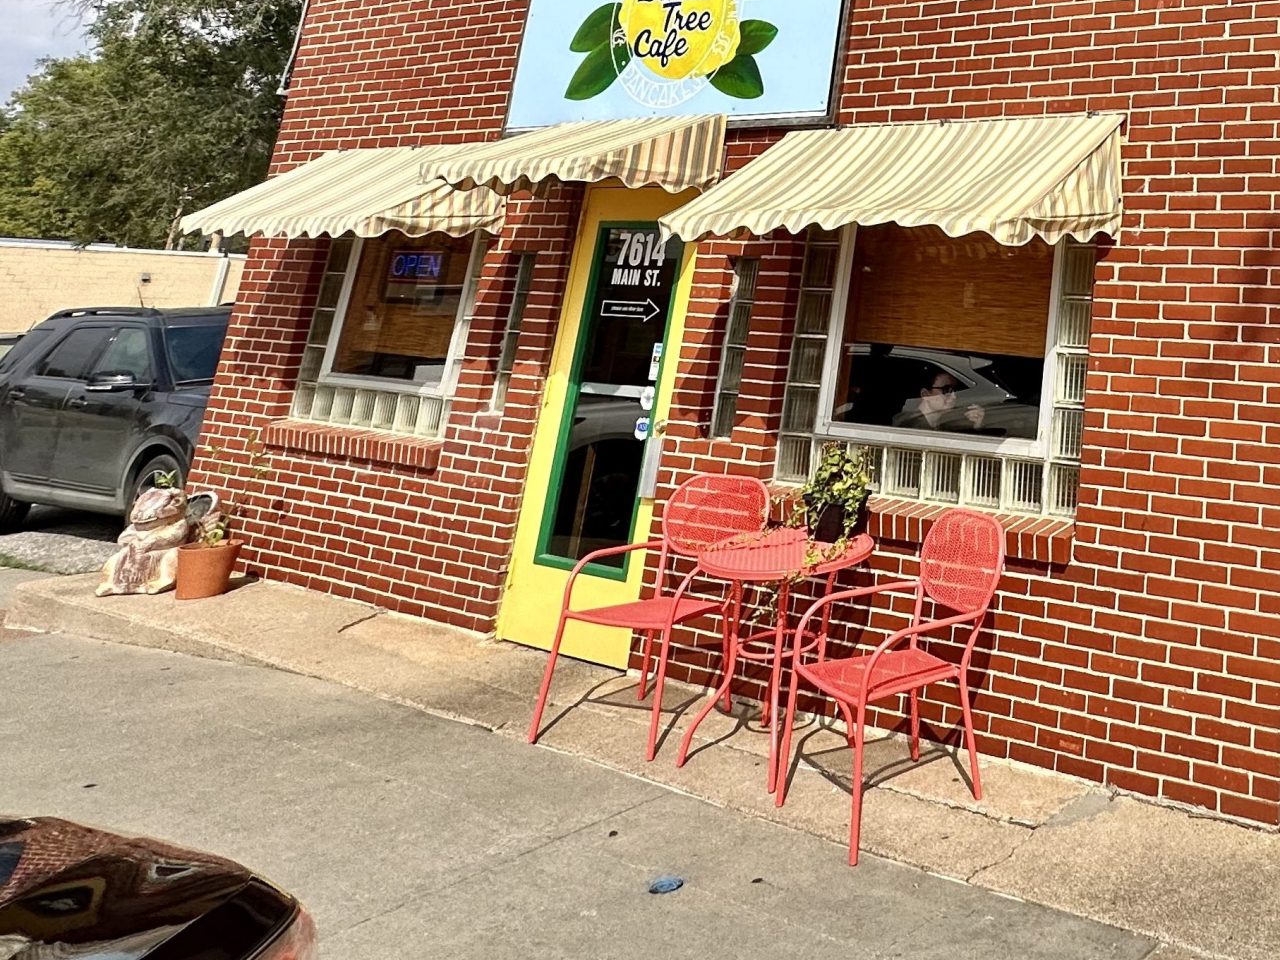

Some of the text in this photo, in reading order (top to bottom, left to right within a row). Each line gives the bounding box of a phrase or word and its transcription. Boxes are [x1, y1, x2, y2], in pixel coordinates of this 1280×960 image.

[663, 1, 713, 33] Tree
[634, 28, 690, 67] Cafe
[393, 255, 441, 277] OPEN
[617, 233, 665, 267] 7614
[611, 269, 661, 286] MAIN ST.
